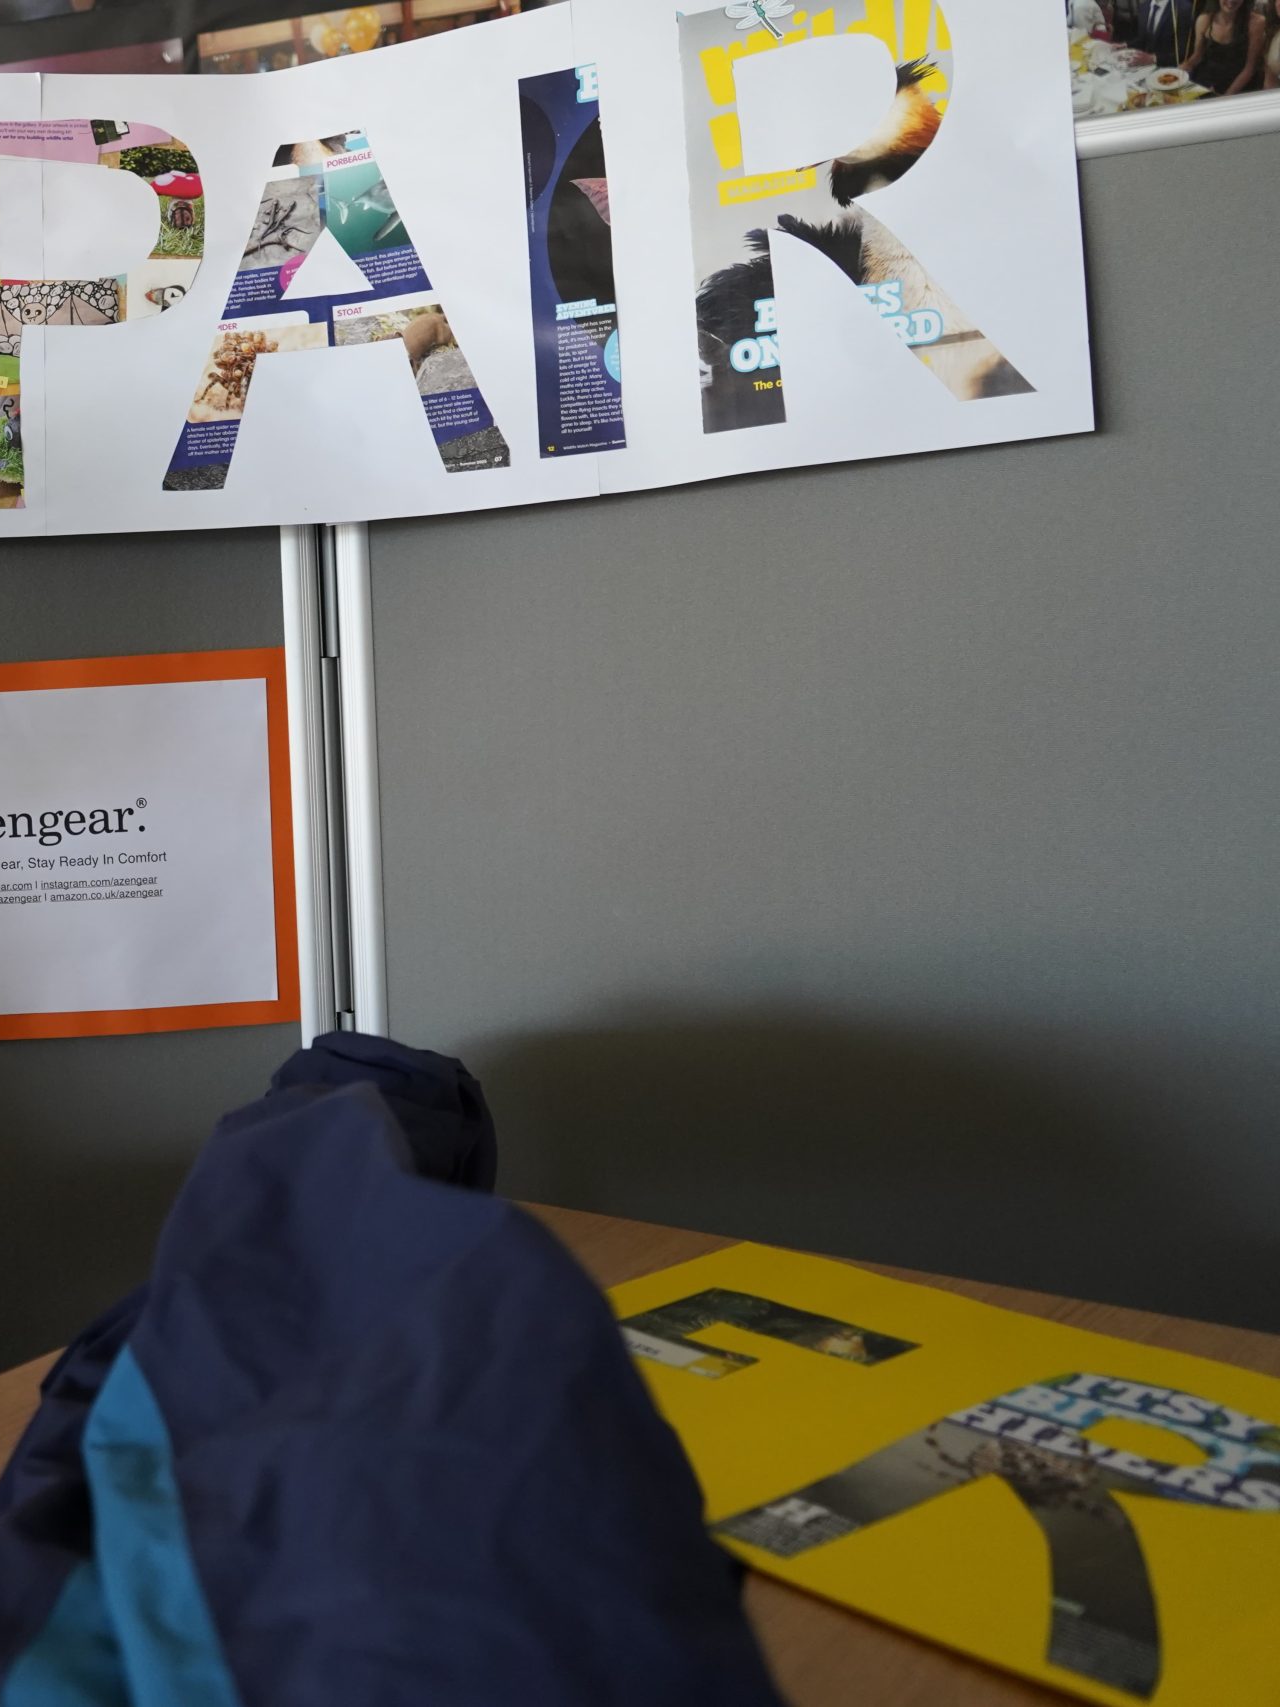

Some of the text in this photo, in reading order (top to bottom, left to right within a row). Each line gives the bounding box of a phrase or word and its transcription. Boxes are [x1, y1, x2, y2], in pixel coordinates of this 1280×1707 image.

[326, 151, 372, 168] PORBEAGLE
[337, 307, 363, 317] STOAT
[753, 380, 774, 391] The
[28, 856, 56, 870] Stay
[59, 854, 99, 868] Ready
[103, 854, 114, 865] In
[118, 850, 167, 864] Comfort
[40, 874, 158, 890] instagram.com/azengear
[50, 887, 163, 902] amazon.co.uk/azengear
